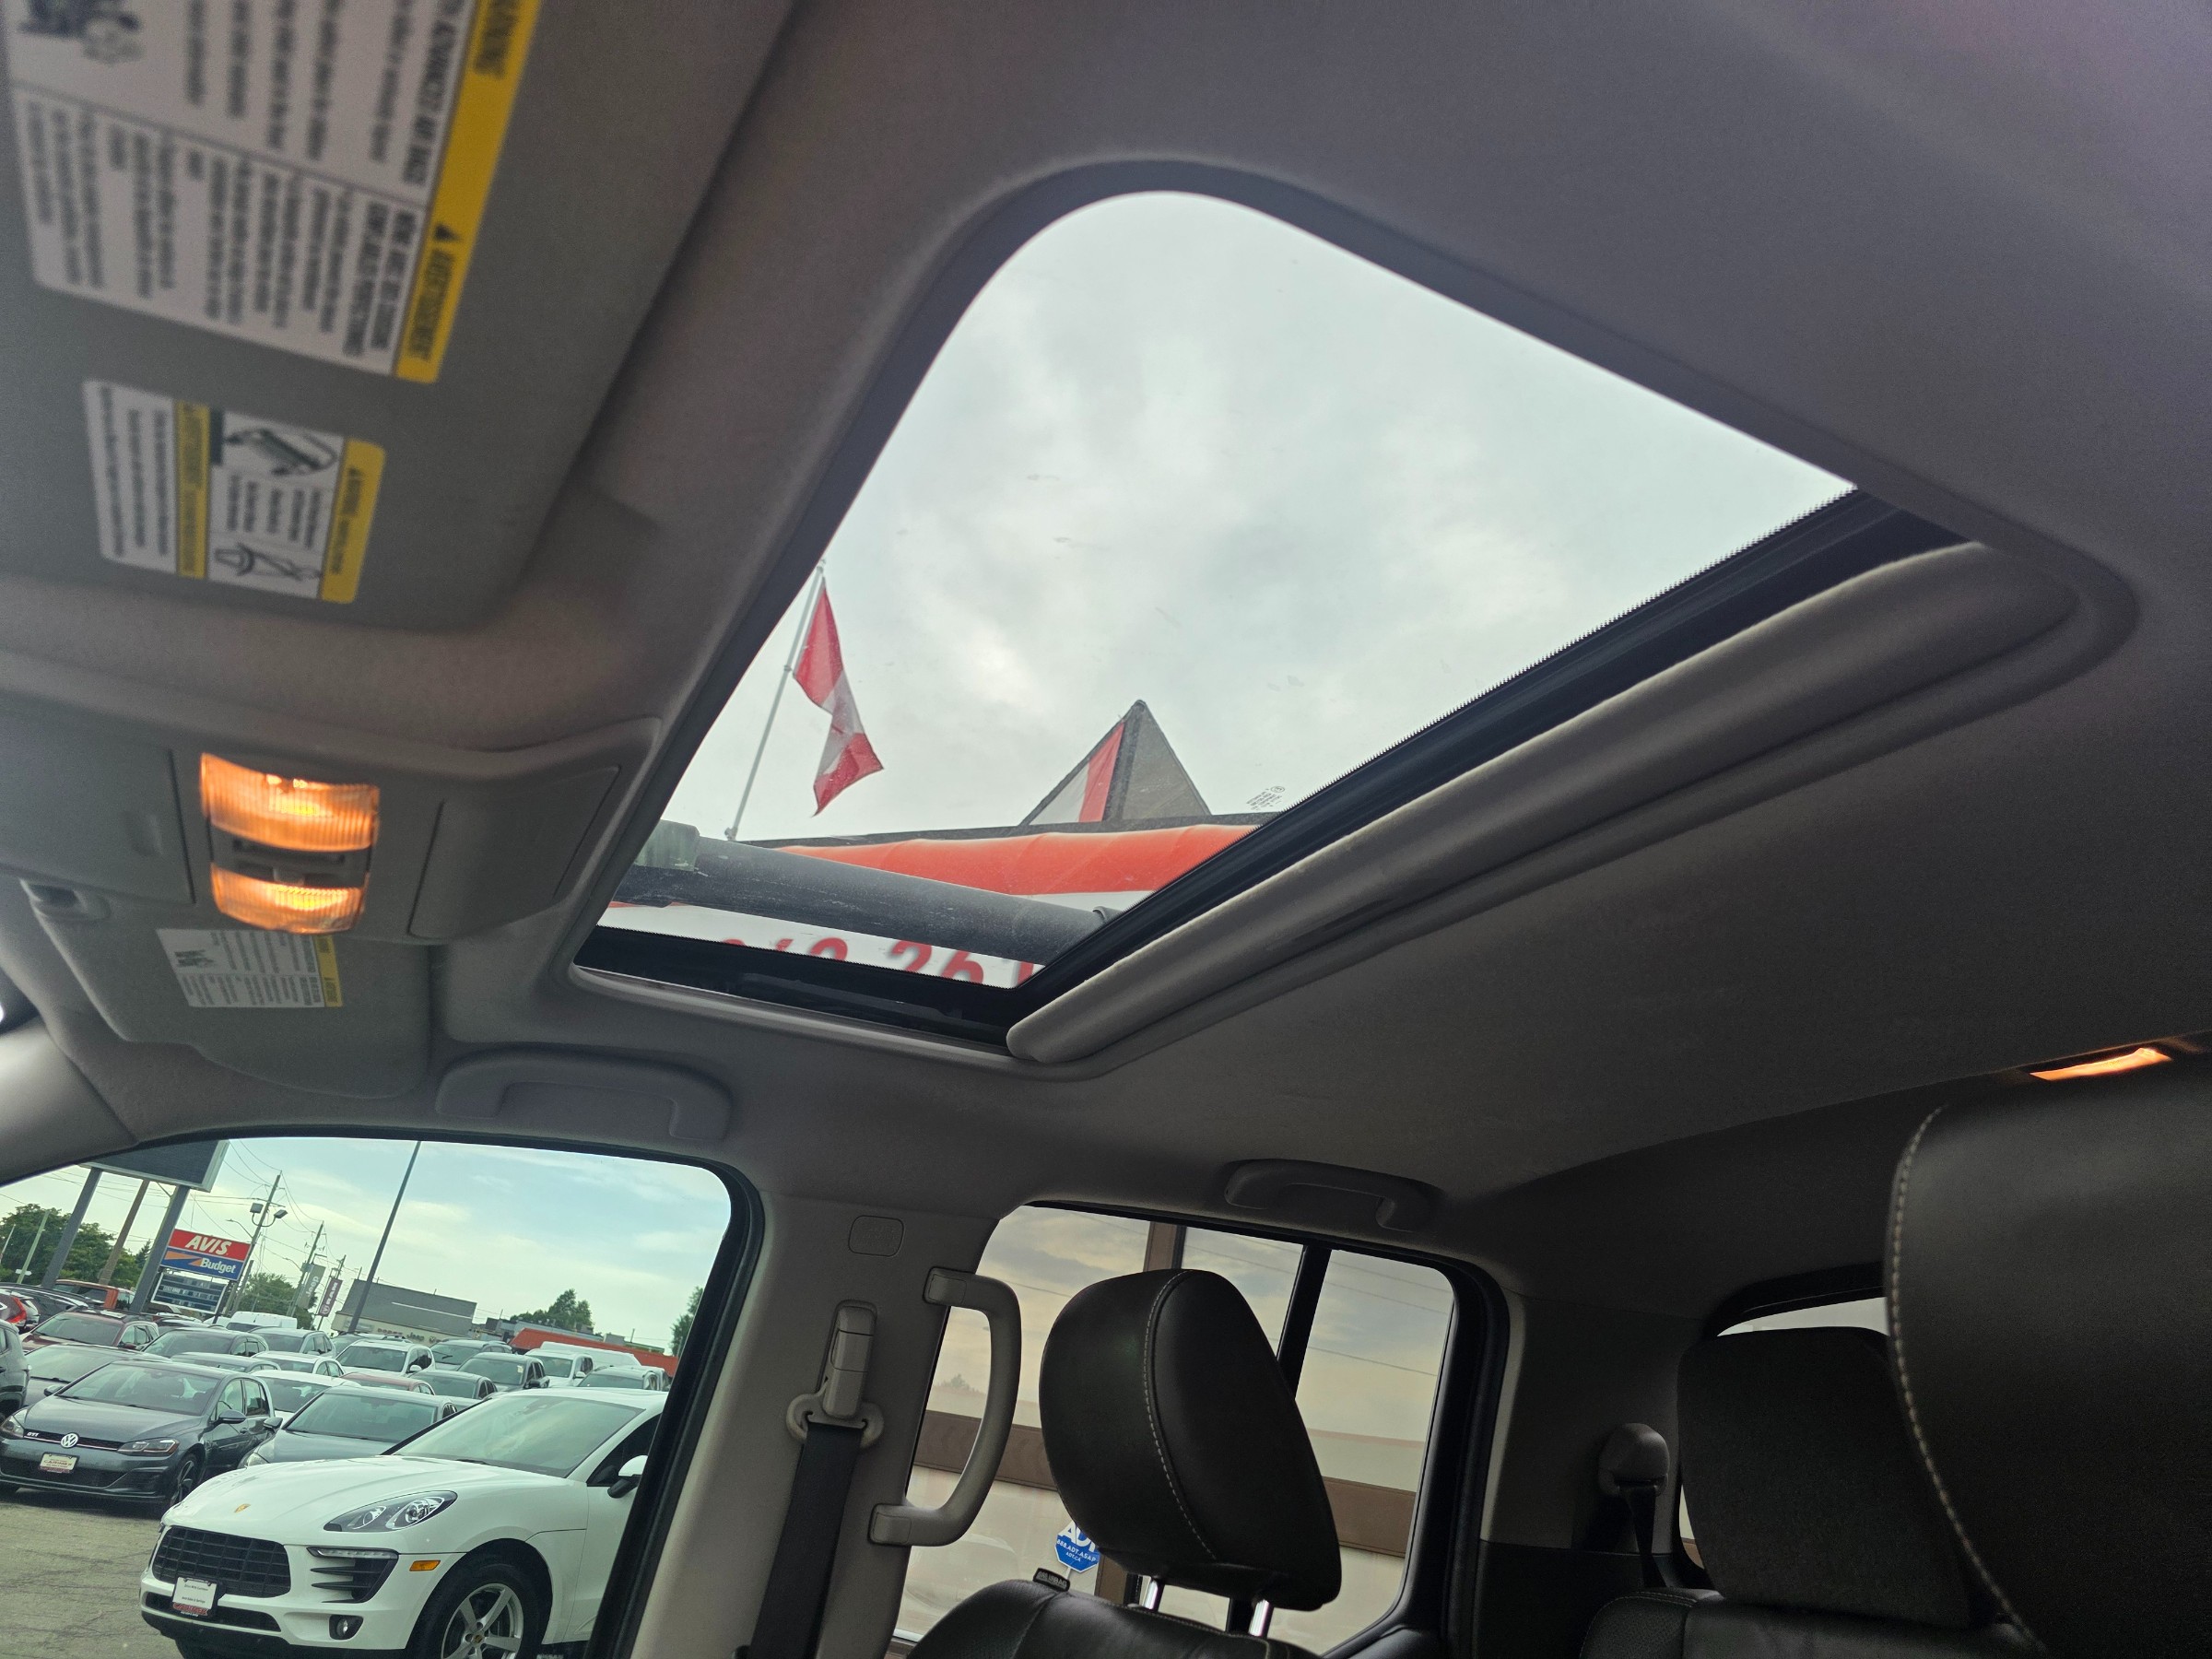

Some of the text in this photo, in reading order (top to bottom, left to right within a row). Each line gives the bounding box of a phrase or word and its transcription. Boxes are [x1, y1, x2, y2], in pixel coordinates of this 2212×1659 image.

[184, 1235, 232, 1255] AVIS
[201, 1257, 237, 1273] Budget
[305, 1276, 319, 1298] Jeep
